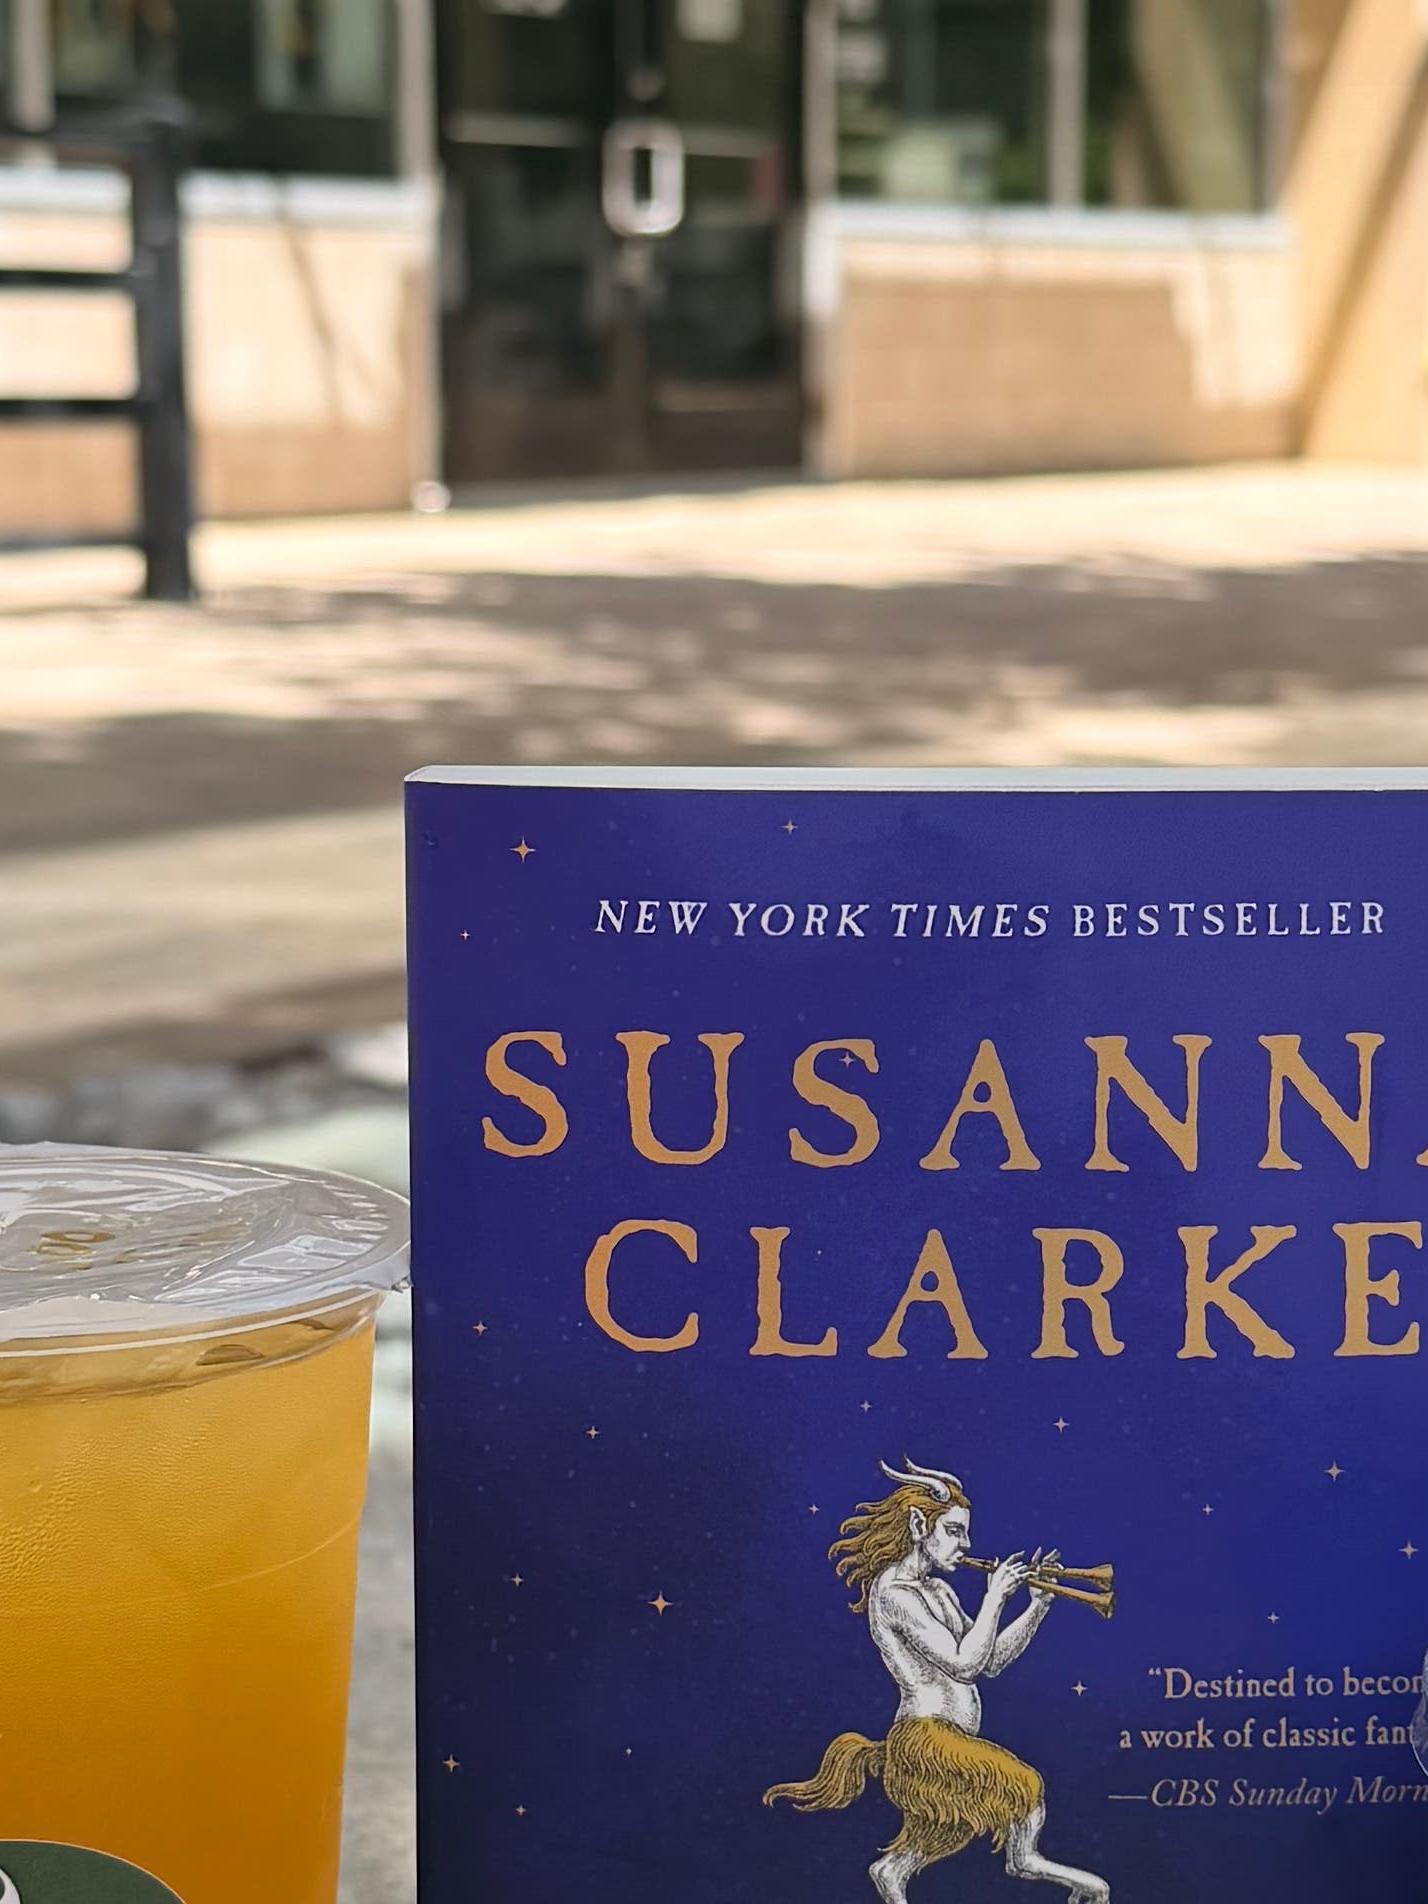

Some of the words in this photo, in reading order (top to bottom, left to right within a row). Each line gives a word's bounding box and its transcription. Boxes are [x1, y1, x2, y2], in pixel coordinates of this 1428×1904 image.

[595, 899, 710, 937] NEW
[728, 901, 870, 939] YORK
[891, 902, 1050, 939] TIMES
[1072, 902, 1387, 938] BESTSELLER
[583, 1217, 1424, 1361] CLARKE
[1148, 1666, 1297, 1700] “Destined
[1305, 1672, 1334, 1697] to
[1119, 1729, 1133, 1750] a
[1141, 1718, 1215, 1750] work
[1223, 1717, 1256, 1749] of
[1262, 1716, 1357, 1749] classic
[1229, 1777, 1339, 1816] Sunday
